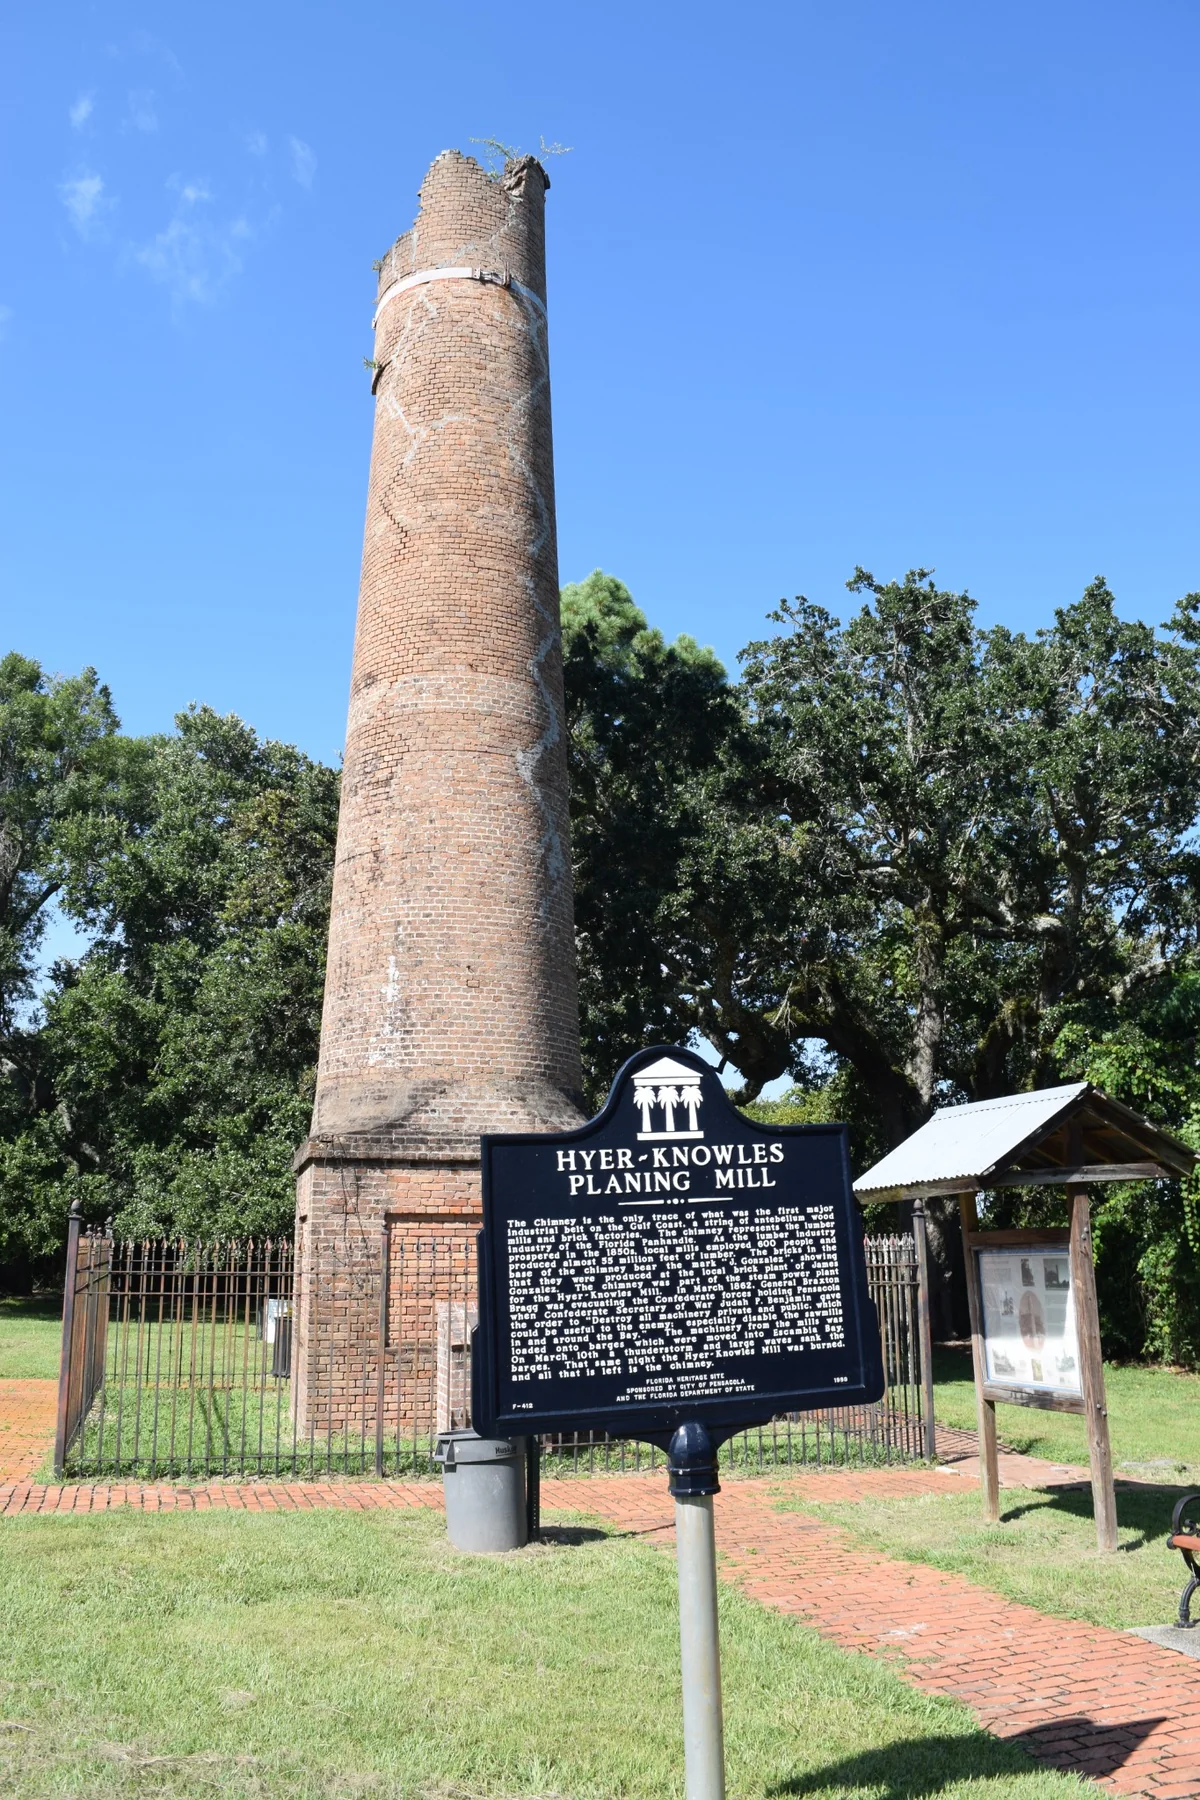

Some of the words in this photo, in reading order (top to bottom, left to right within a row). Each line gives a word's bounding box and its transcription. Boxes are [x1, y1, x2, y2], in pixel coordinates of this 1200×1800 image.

[568, 1170, 691, 1196] PLANING
[714, 1167, 776, 1189] MILL
[507, 1227, 558, 1236] industrial
[704, 1219, 733, 1227] string
[754, 1215, 804, 1224] antebellum
[533, 1217, 576, 1227] Chimney
[622, 1214, 643, 1223] only
[806, 1205, 833, 1214] major
[508, 1244, 551, 1254] industry
[598, 1239, 634, 1248] Florida
[756, 1231, 788, 1239] lumber
[796, 1229, 835, 1238] industry
[537, 1235, 554, 1243] and
[682, 1227, 722, 1236] chimney
[728, 1224, 779, 1234] represents
[804, 1221, 834, 1229] lumber
[508, 1252, 559, 1262] prospered
[583, 1249, 599, 1257] the
[675, 1244, 698, 1252] mills
[706, 1241, 751, 1251] employed
[783, 1238, 813, 1247] people
[509, 1278, 530, 1286] that
[539, 1277, 562, 1285] they
[604, 1271, 651, 1281] produced
[733, 1265, 757, 1273] brick
[764, 1263, 787, 1272] plant
[811, 1260, 838, 1268] James
[575, 1283, 592, 1291] The
[601, 1280, 643, 1290] chimney
[679, 1277, 699, 1285] part
[748, 1272, 775, 1280] steam
[782, 1271, 810, 1279] power
[815, 1268, 838, 1277] plant
[509, 1296, 524, 1304] for
[557, 1290, 631, 1302] Hyer-Knowles
[693, 1284, 723, 1292] March
[760, 1280, 796, 1288] General
[802, 1277, 839, 1285] Braxton
[509, 1304, 538, 1313] Bragg
[571, 1298, 624, 1309] evacuating
[632, 1296, 648, 1304] the
[655, 1292, 715, 1302] Confederate
[721, 1290, 751, 1298] forces
[758, 1287, 792, 1297] holding
[797, 1284, 839, 1293] Pensacola
[510, 1312, 535, 1320] when
[544, 1307, 608, 1318] Confederate
[616, 1304, 666, 1314] Secretary
[720, 1298, 748, 1306] Judah
[767, 1294, 811, 1304] Benjamin
[510, 1321, 526, 1329] the
[534, 1319, 562, 1327] order
[659, 1309, 710, 1320] machinery
[717, 1306, 751, 1316] private
[815, 1300, 841, 1308] which
[512, 1346, 545, 1355] loaded
[556, 1343, 578, 1352] onto
[589, 1340, 624, 1350] barges
[634, 1337, 663, 1346] which
[706, 1332, 736, 1340] moved
[744, 1330, 764, 1338] into
[773, 1326, 817, 1336] Escambia
[564, 1360, 587, 1368] That
[628, 1355, 655, 1364] night
[661, 1353, 677, 1361] the
[684, 1347, 754, 1360] Hyer-Knowles
[761, 1345, 780, 1353] Mill
[511, 1373, 529, 1381] and
[538, 1371, 551, 1379] all
[558, 1369, 579, 1377] that
[602, 1366, 621, 1374] left
[645, 1363, 661, 1371] the
